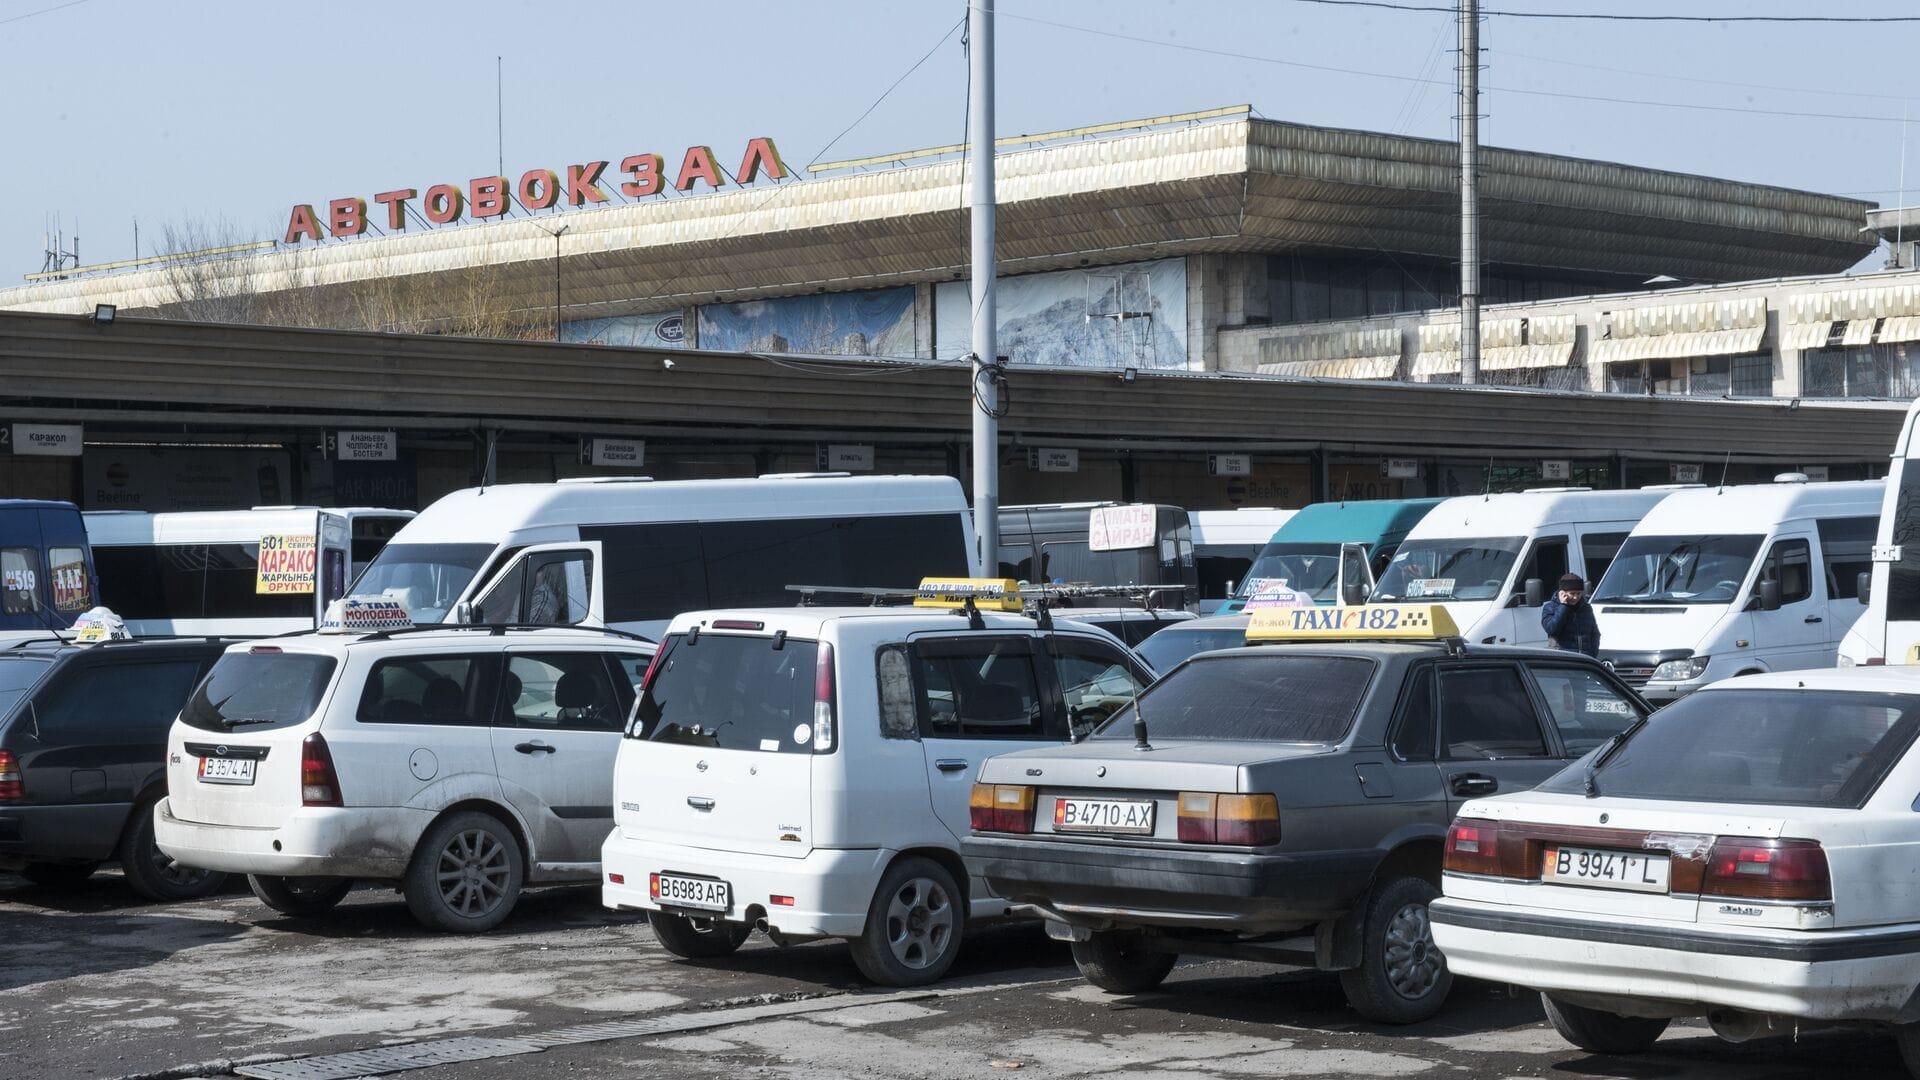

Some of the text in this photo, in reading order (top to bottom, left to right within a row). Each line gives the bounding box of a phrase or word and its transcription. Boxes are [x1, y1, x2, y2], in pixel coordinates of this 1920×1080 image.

[284, 137, 788, 244] АВТОВОКЗАЛ
[327, 435, 336, 450] 3
[1095, 508, 1153, 526] АЛМАТЫ
[262, 536, 283, 550] 501
[1093, 528, 1153, 547] САЙРАН
[260, 549, 316, 573] КАРАКО
[15, 569, 36, 590] 519
[345, 609, 407, 620] МОЛОДЕЖЬ
[1291, 609, 1344, 630] TAXI
[1355, 608, 1399, 630] 182
[206, 759, 214, 775] B
[215, 759, 238, 777] 3574
[1064, 803, 1151, 827] B 4710 AX
[1556, 850, 1657, 884] B 9941 L
[661, 878, 726, 904] B 6983 AR
